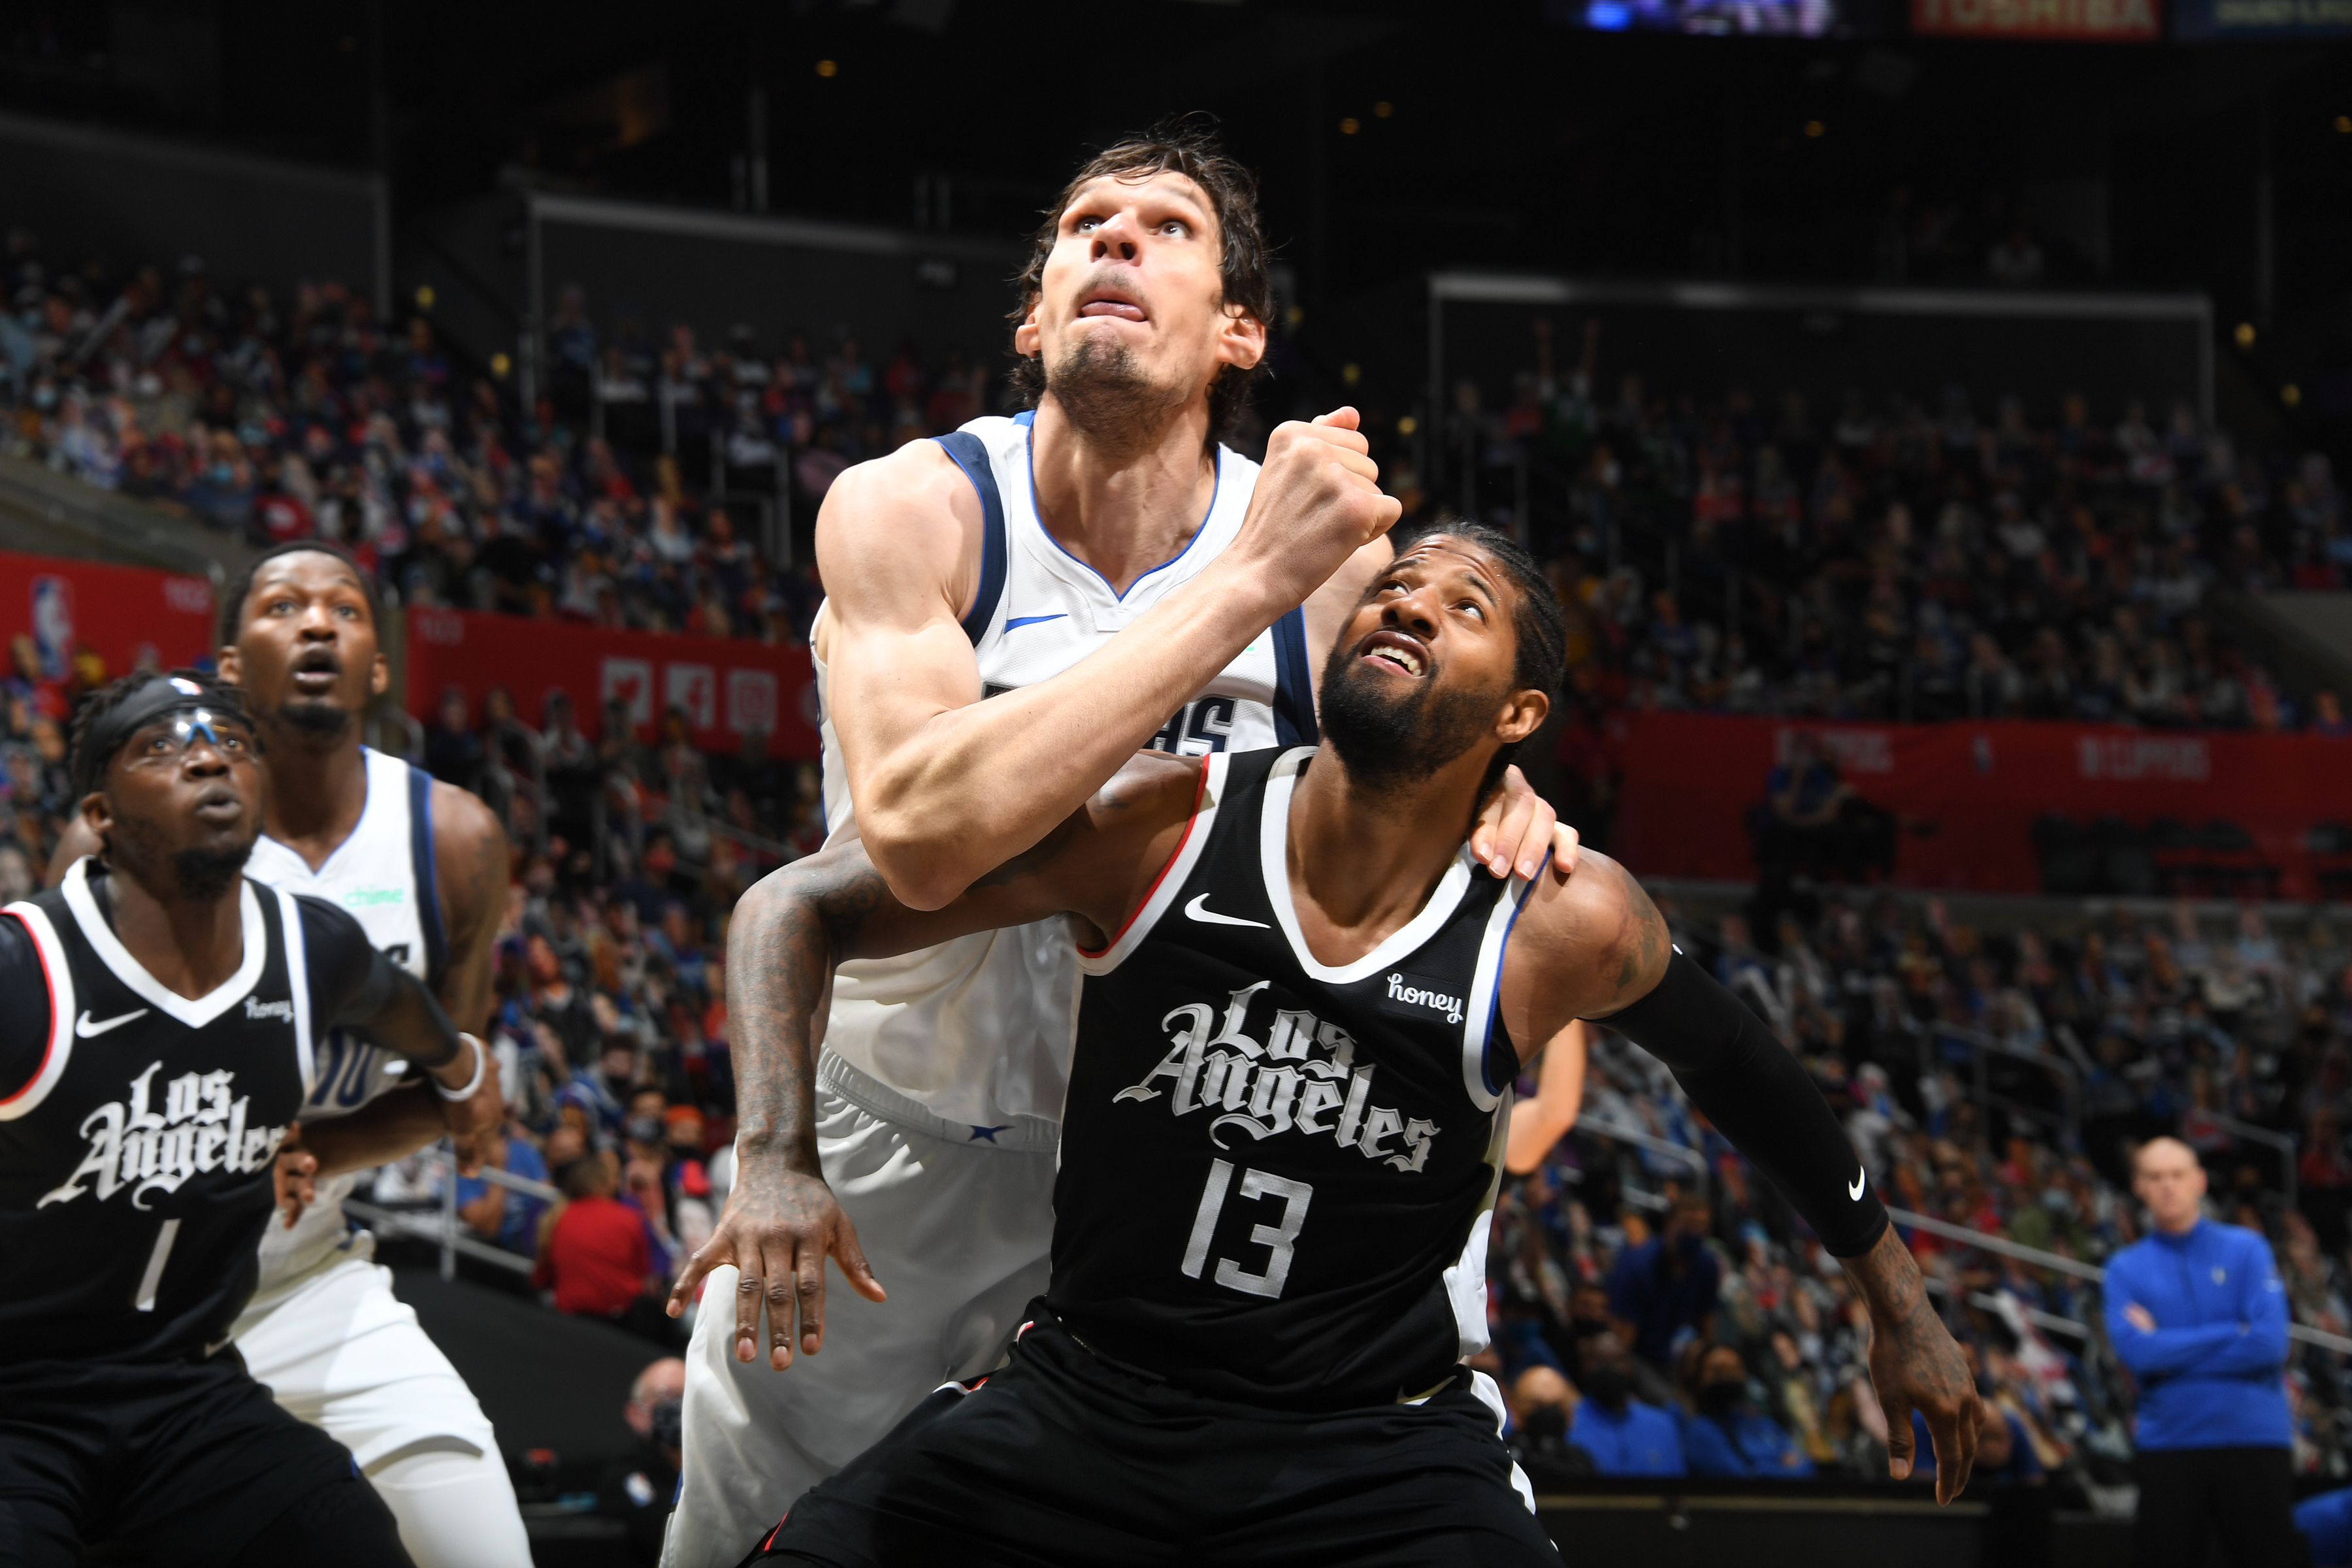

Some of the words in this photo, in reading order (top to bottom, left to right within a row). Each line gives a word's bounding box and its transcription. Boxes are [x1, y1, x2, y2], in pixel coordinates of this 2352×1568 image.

[344, 885, 404, 907] chime
[243, 995, 295, 1024] honey
[1207, 980, 1358, 1080] Los
[1387, 973, 1463, 1024] honey
[129, 1060, 236, 1124] Los
[1112, 1003, 1441, 1173] Angeles
[136, 1218, 181, 1312] 1
[1181, 1158, 1314, 1299] 13
